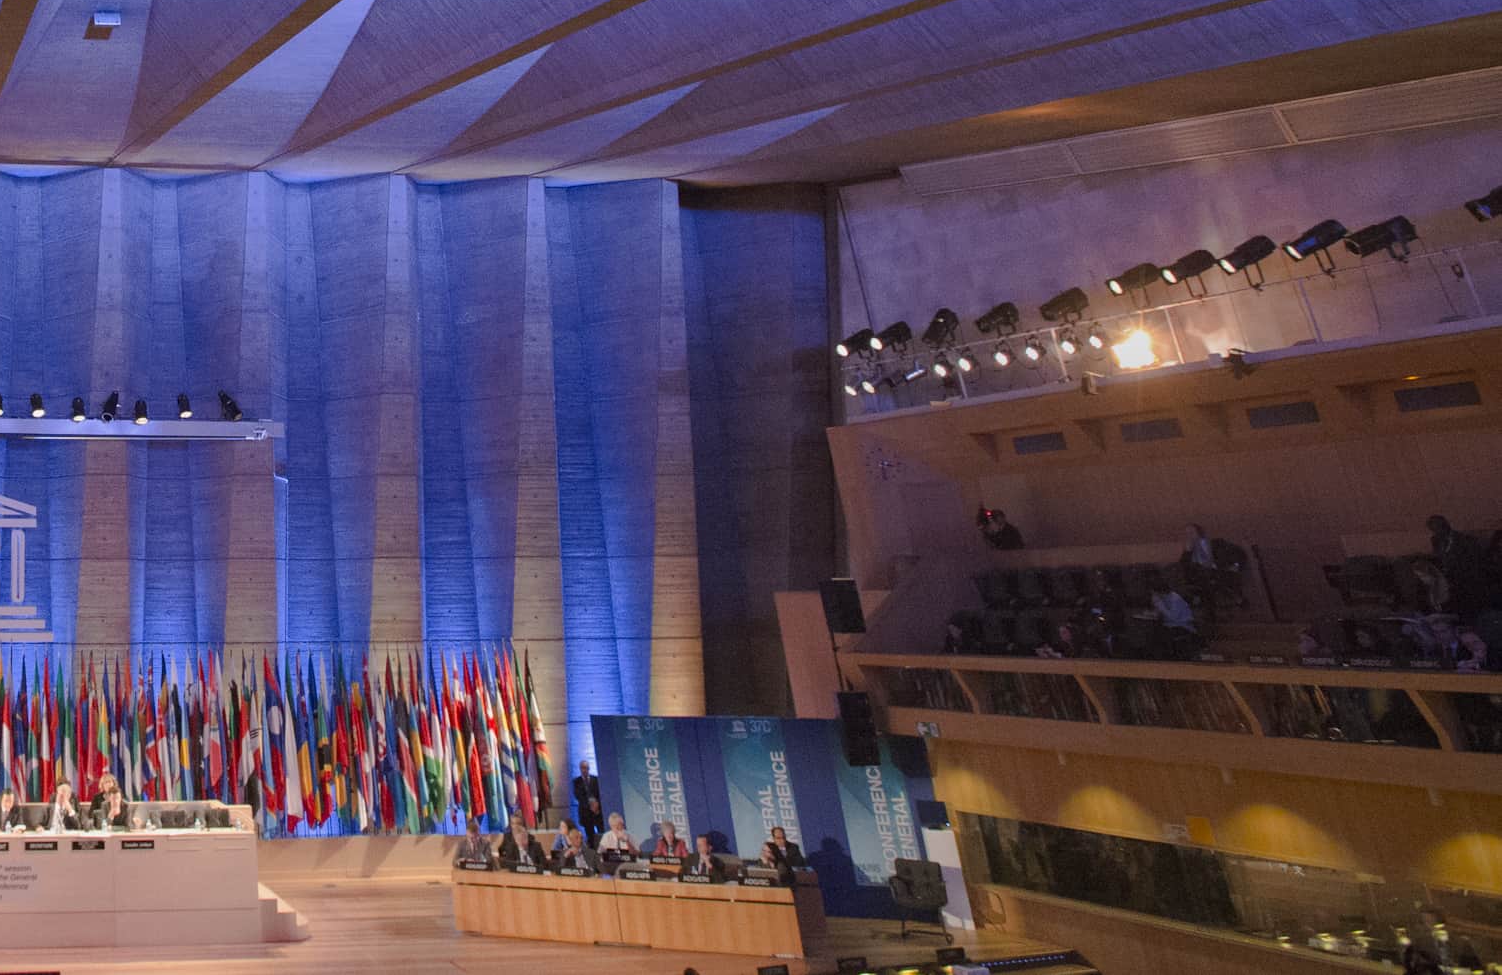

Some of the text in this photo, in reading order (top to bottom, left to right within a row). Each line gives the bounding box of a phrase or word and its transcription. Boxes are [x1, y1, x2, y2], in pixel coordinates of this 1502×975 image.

[750, 720, 771, 733] 37C
[645, 747, 666, 824] FÉRENCE
[666, 770, 688, 839] NÉRALE
[760, 785, 779, 835] NERAL
[770, 750, 798, 842] NFERENCE
[891, 791, 918, 860] ENERAL
[10, 873, 38, 882] General
